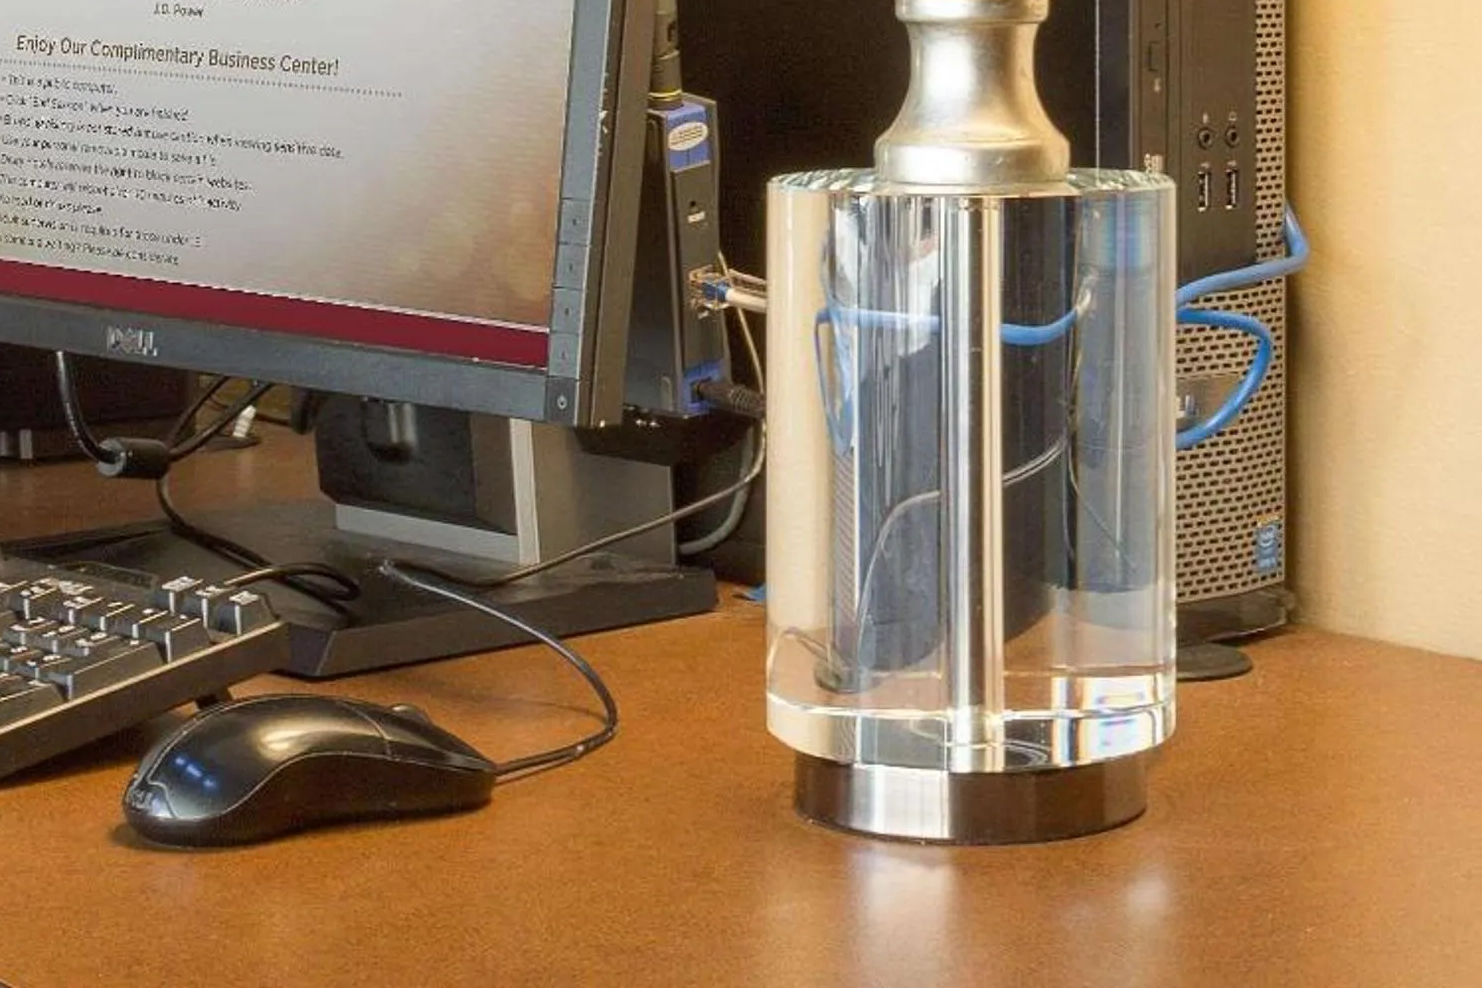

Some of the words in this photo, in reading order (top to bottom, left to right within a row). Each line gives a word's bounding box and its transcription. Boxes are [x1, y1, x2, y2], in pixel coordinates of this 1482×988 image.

[16, 34, 57, 56] Enjoy
[60, 37, 87, 56] Our
[90, 38, 205, 68] Complimentary
[208, 48, 276, 71] Business
[280, 53, 340, 76] Center!
